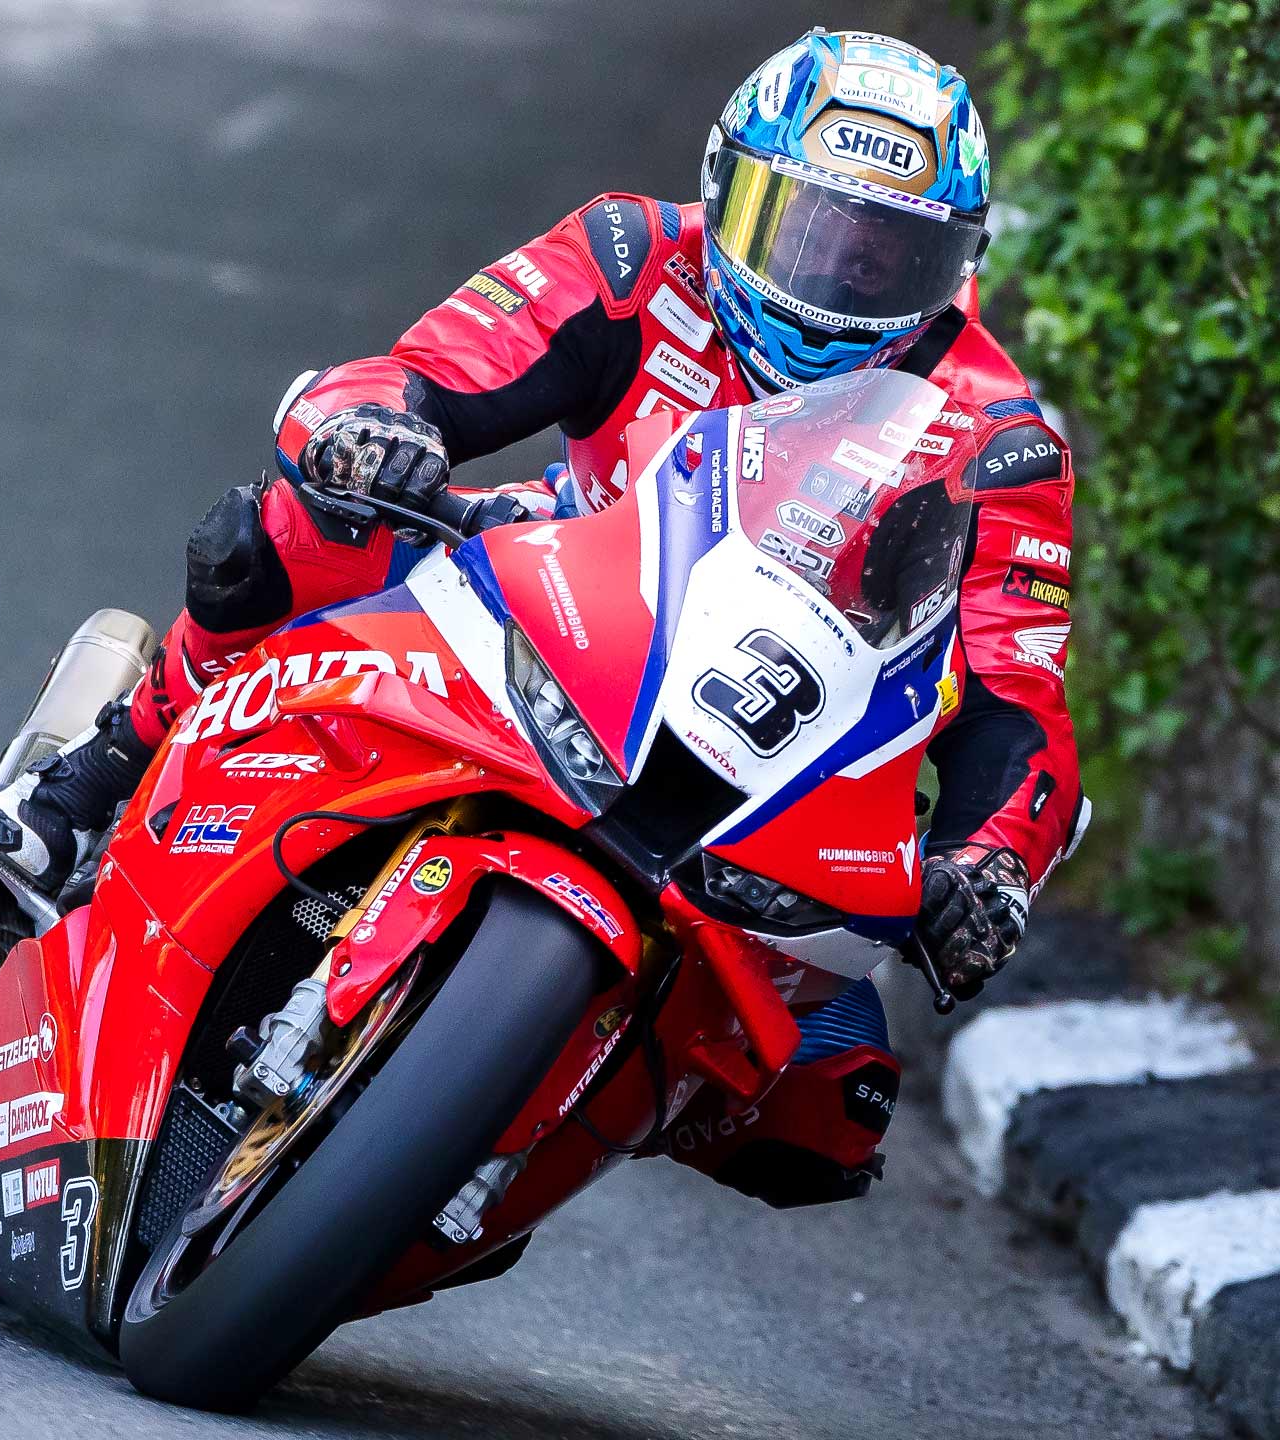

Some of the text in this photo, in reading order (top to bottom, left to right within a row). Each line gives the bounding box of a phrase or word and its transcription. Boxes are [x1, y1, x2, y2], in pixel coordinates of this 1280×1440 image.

[840, 87, 906, 109] SOLUTIONS
[835, 127, 914, 169] SHOEI
[603, 202, 632, 279] SPADA
[499, 250, 550, 298] OTUL
[732, 262, 917, 330] apacheautomotive.co.uk
[656, 349, 711, 390] HONDA
[752, 352, 772, 374] RED
[741, 425, 767, 482] WRS
[985, 442, 1060, 475] SPADA
[711, 448, 722, 533] Honda RACING
[785, 506, 836, 542] SHOEI
[1015, 535, 1071, 570] MOT
[542, 554, 589, 650] HUMMINGBIRD
[754, 564, 844, 641] METZELER
[1029, 579, 1070, 610] AKRAPO
[690, 627, 827, 761] 3
[220, 752, 320, 773] CBR
[686, 730, 738, 779] HONDA
[226, 770, 302, 781] FIREBLADE
[169, 844, 235, 855] Honda RACING
[818, 848, 895, 864] HUMMINGBIRD
[830, 865, 887, 874] LOGISTIC SERVICES
[362, 839, 428, 924] METZELER
[558, 1028, 622, 1117] METZELER
[11, 1099, 52, 1137] DATATOOL
[26, 1164, 59, 1204] MOTUL
[59, 1175, 100, 1293] 3
